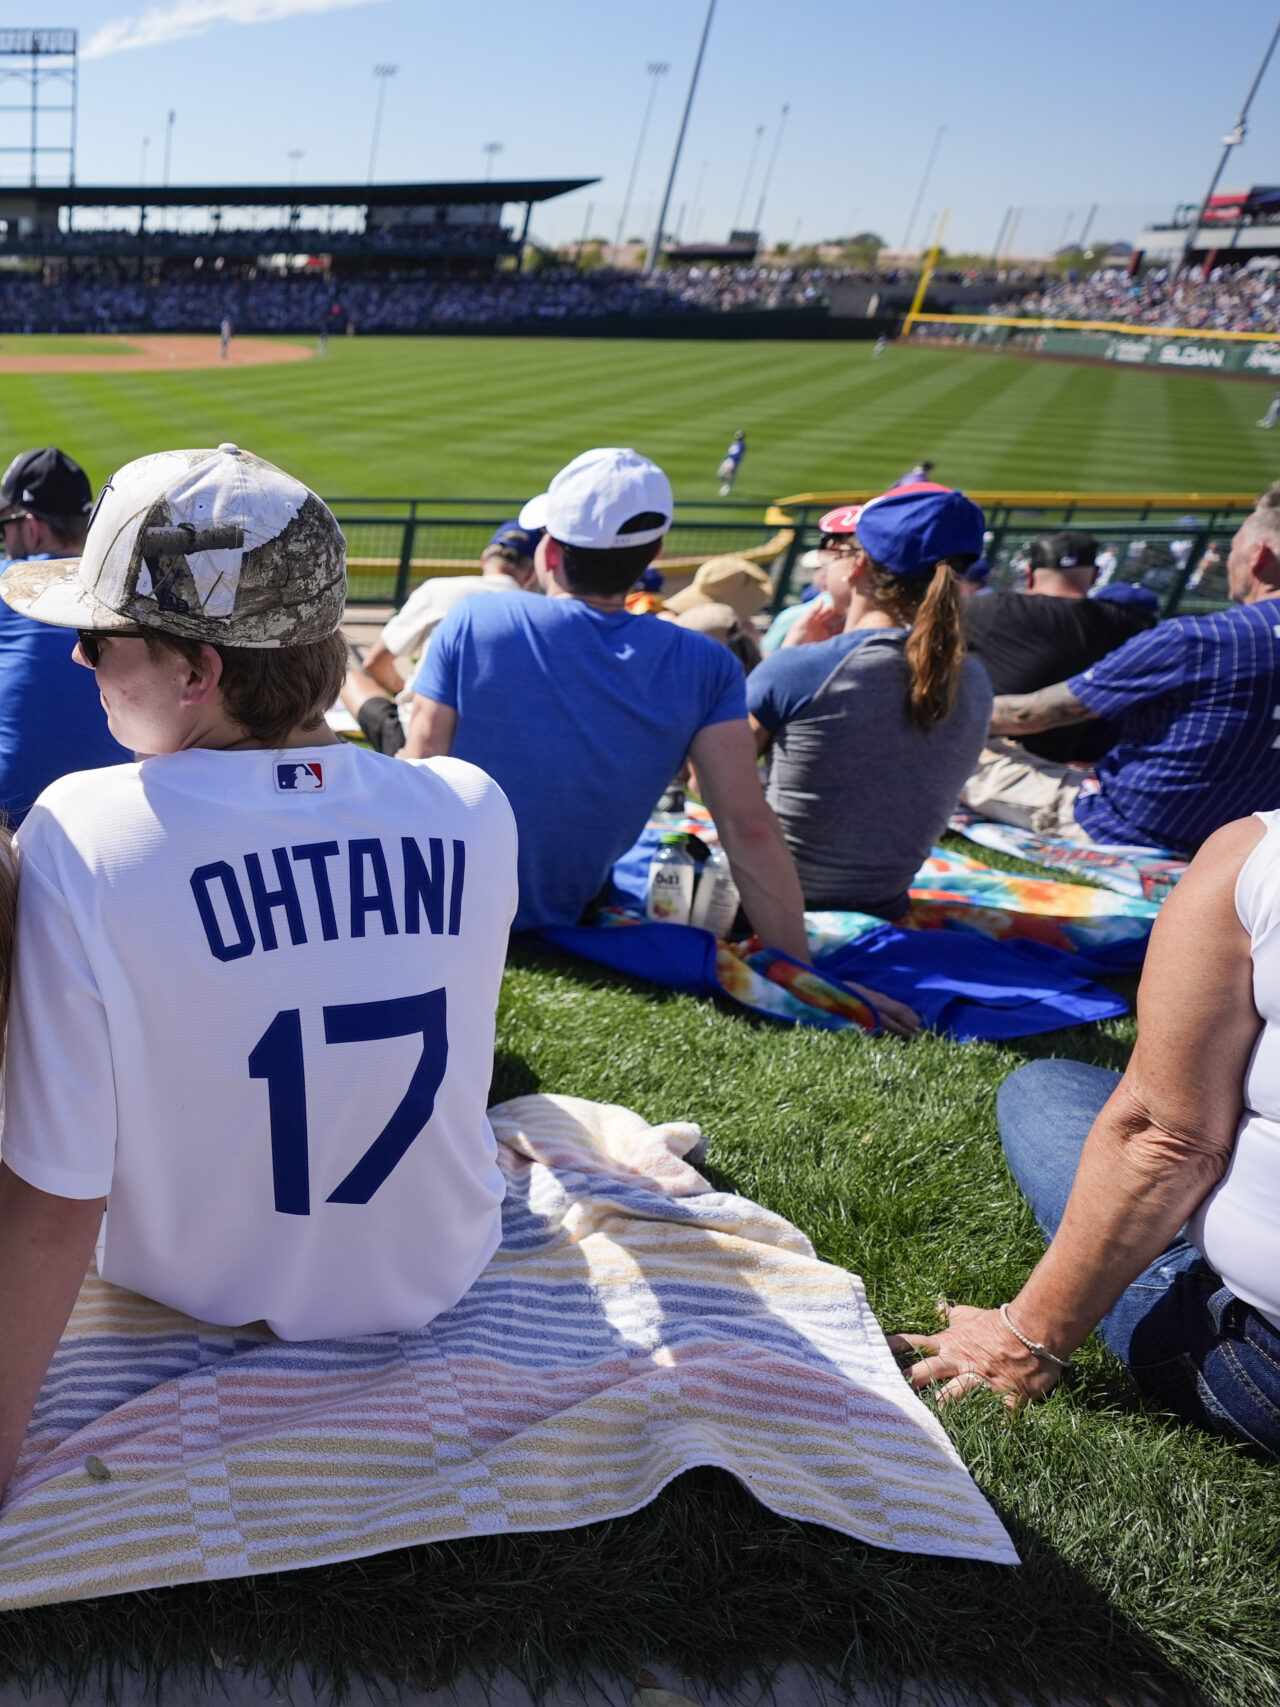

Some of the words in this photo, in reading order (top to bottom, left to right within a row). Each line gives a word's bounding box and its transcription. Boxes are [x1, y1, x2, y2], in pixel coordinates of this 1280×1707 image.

[1158, 344, 1225, 368] SLOAN
[190, 837, 466, 962] OHTANI
[248, 986, 449, 1216] 17
